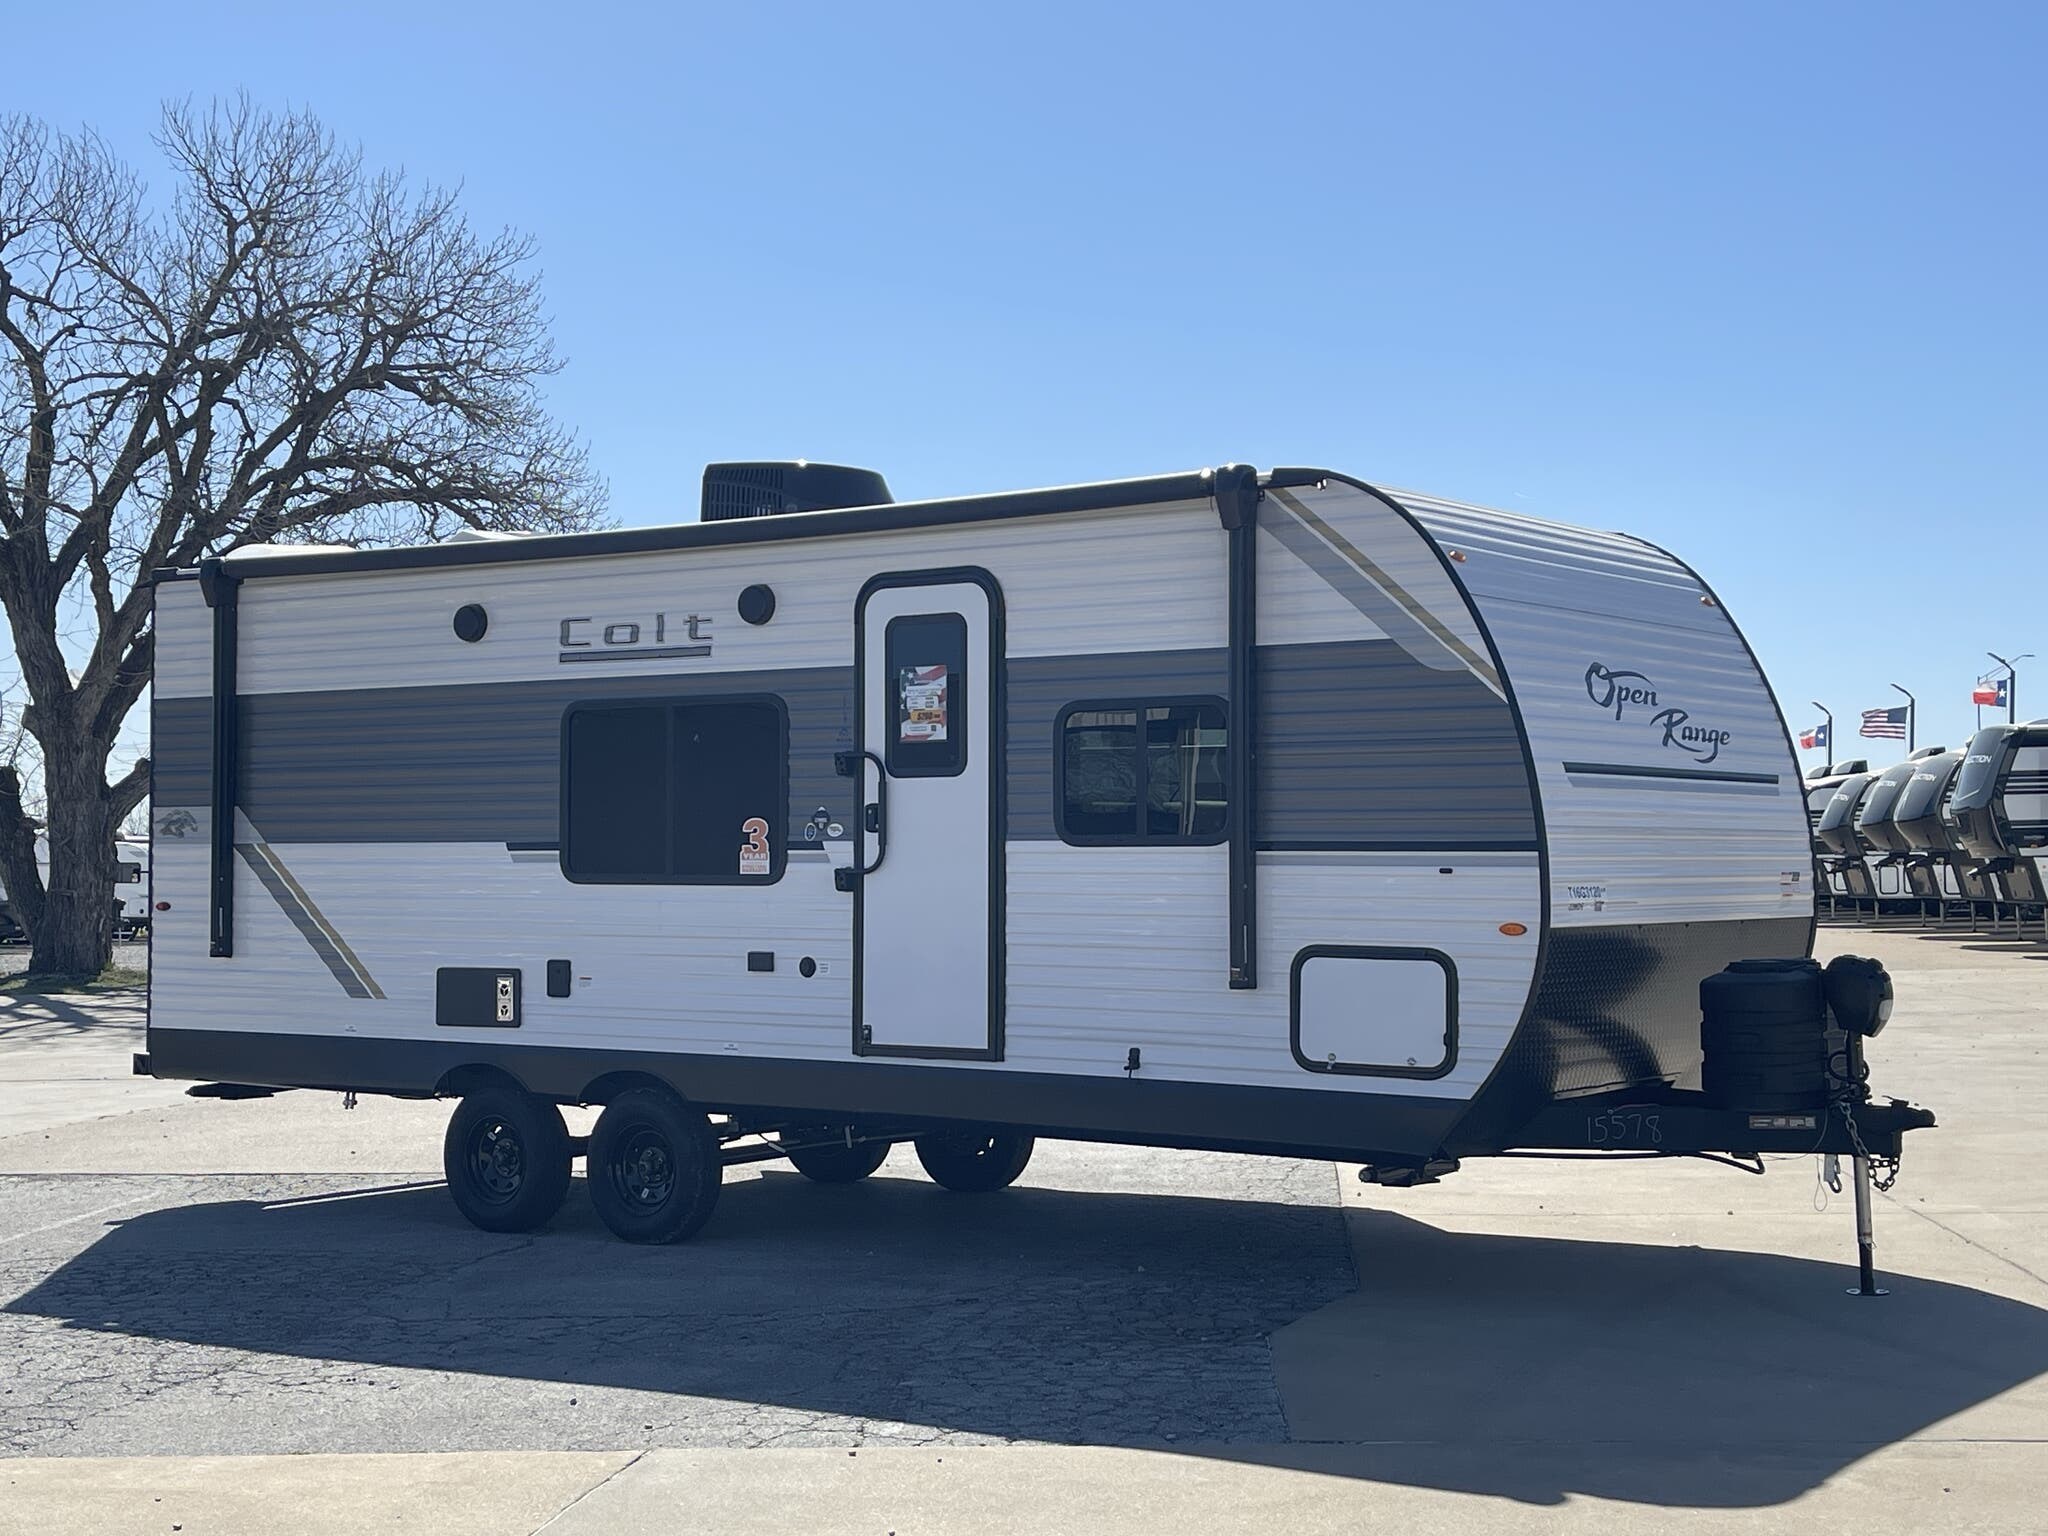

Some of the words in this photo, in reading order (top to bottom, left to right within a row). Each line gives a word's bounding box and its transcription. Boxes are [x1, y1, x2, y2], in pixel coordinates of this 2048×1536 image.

[560, 613, 713, 646] Colt
[1585, 662, 1658, 720] Open
[1649, 708, 1730, 763] Range
[742, 817, 769, 852] 3
[743, 852, 767, 860] YEAR
[1587, 1113, 1662, 1143] 15578
